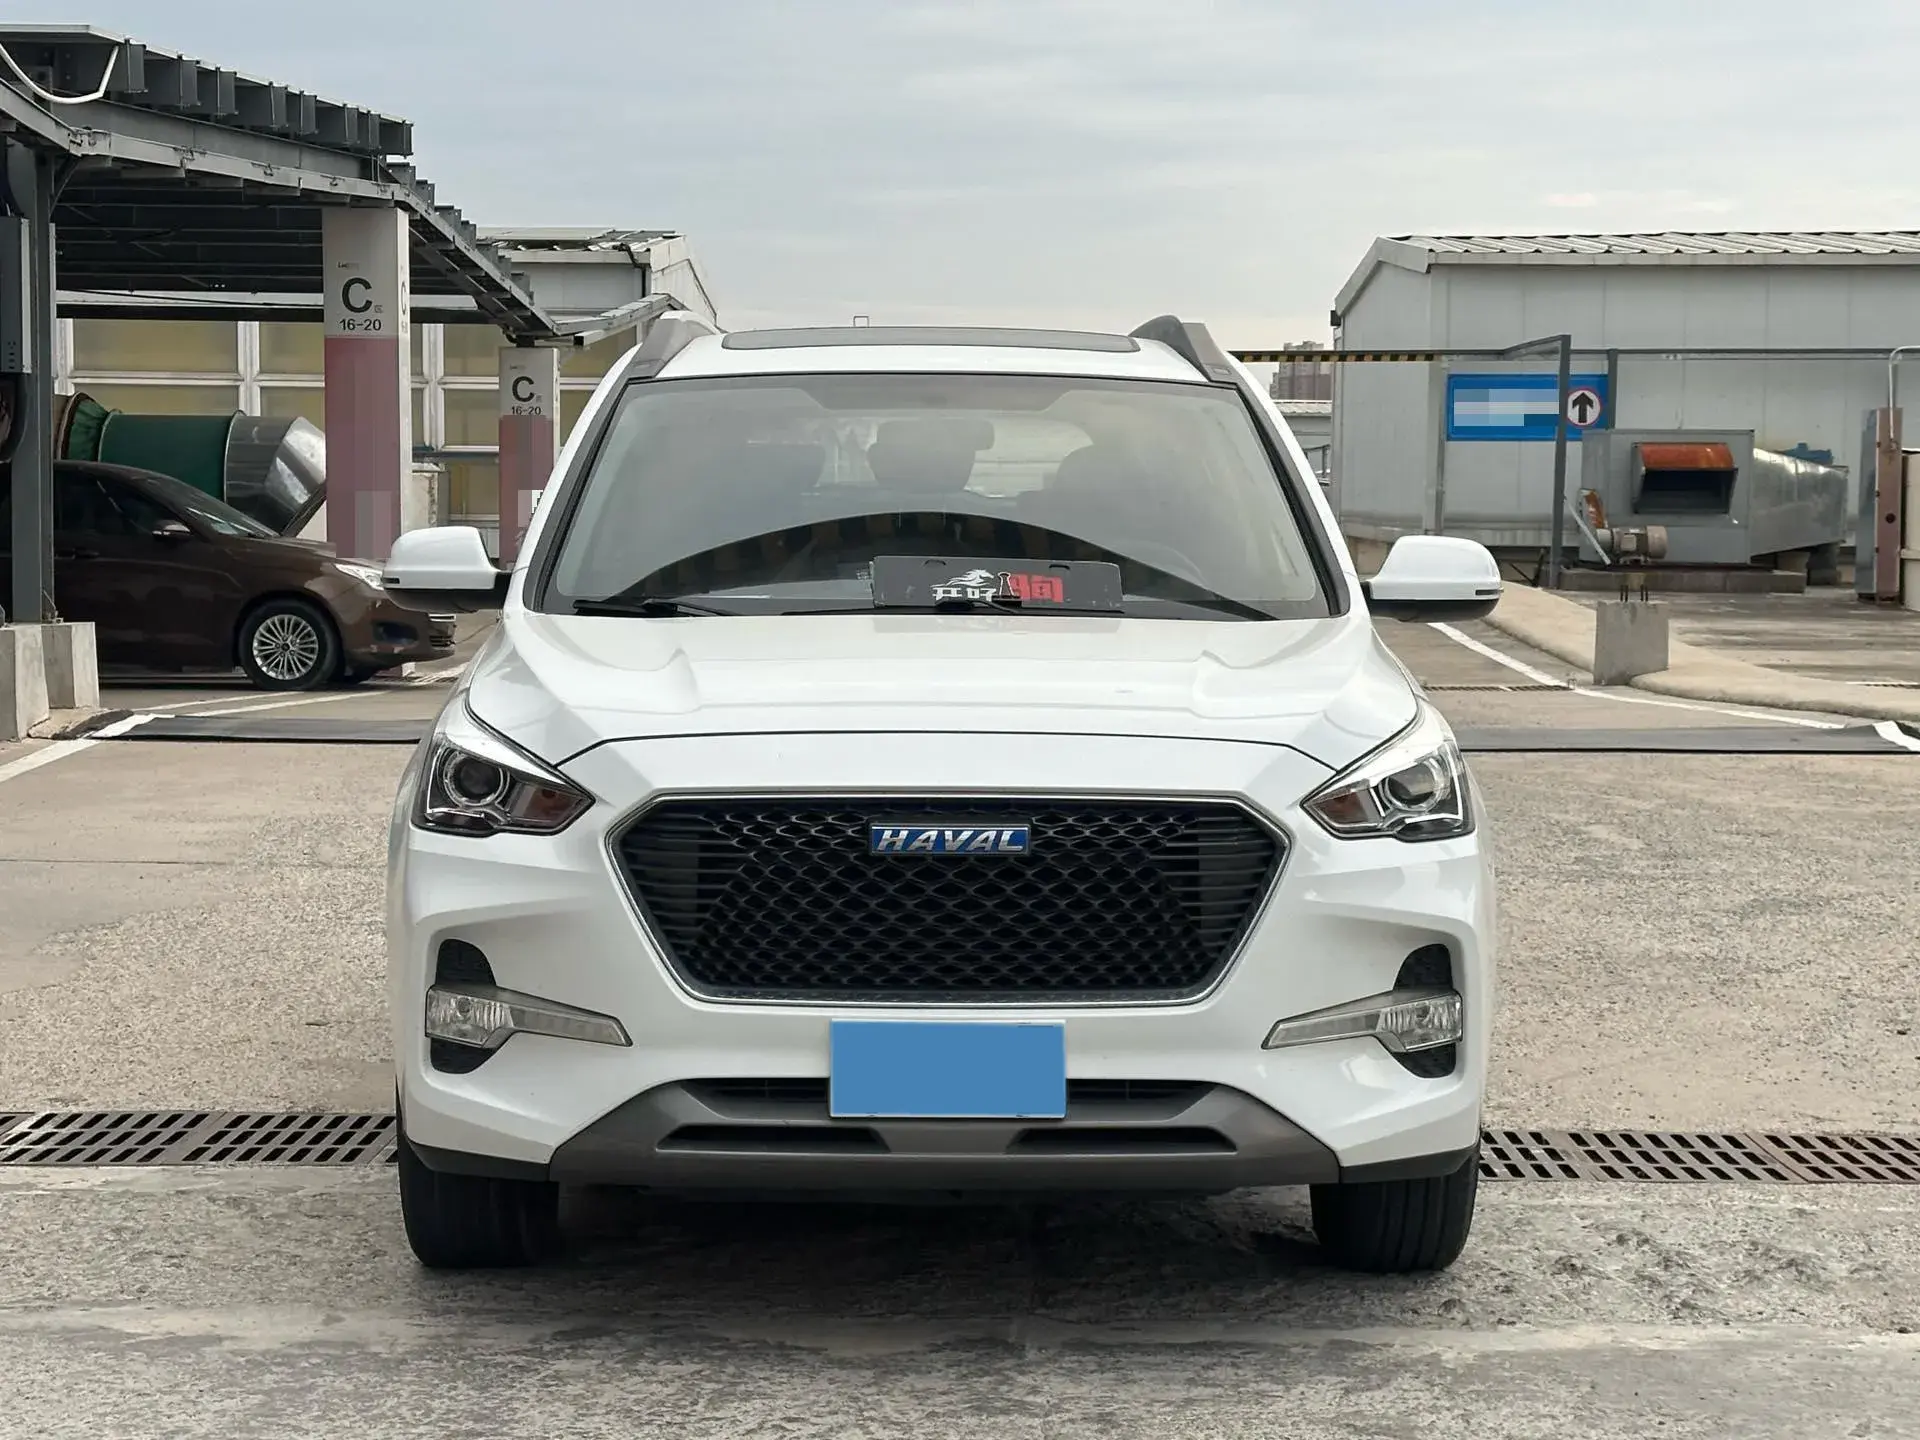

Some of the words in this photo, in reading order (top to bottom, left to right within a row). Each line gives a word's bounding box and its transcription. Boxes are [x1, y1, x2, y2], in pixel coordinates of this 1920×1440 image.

[342, 277, 372, 313] C
[339, 318, 382, 331] 16-20
[512, 376, 534, 402] C
[511, 406, 542, 416] 16-20
[876, 829, 1023, 851] HAVAL
